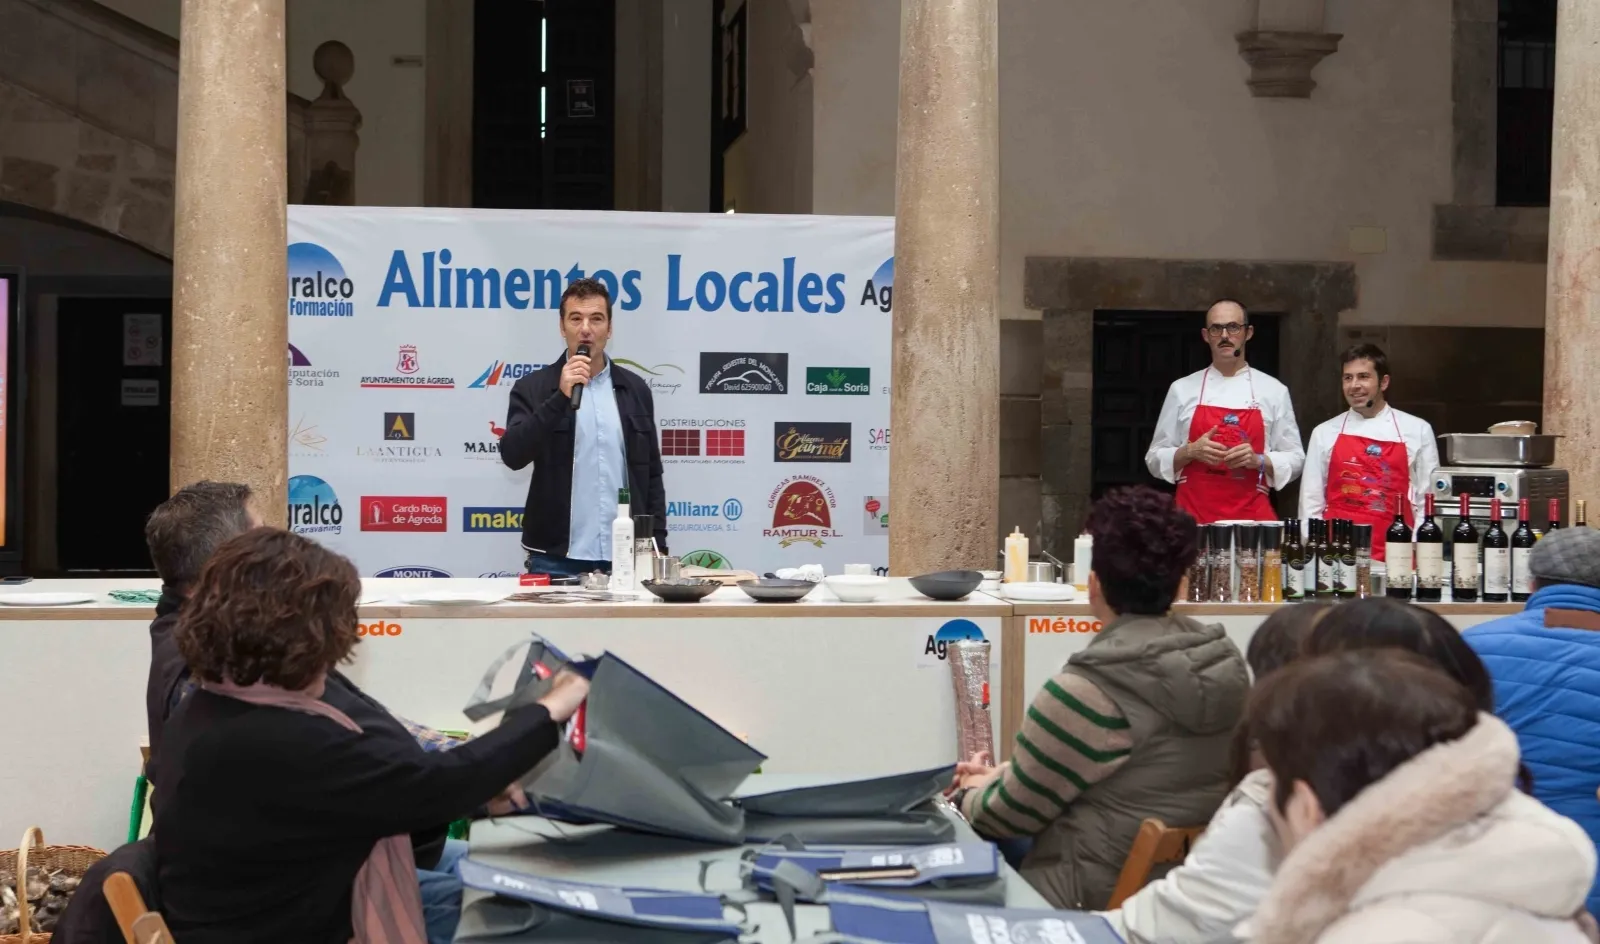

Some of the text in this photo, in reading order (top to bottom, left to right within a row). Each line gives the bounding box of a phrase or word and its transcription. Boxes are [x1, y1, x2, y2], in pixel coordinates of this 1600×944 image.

[666, 254, 846, 314] Locales
[290, 298, 353, 316] Formación
[360, 376, 415, 384] AYUNTAMIENTO
[427, 376, 455, 385] ÁGREDA
[748, 358, 758, 366] DEL
[759, 362, 785, 392] MONCAYO
[296, 377, 325, 387] Soria
[807, 382, 828, 394] Caja
[844, 382, 869, 393] Soria
[660, 419, 746, 428] DISTRIBUCIONES
[776, 432, 849, 460] Gourmet
[824, 487, 837, 509] TUTOR
[392, 504, 443, 515] Cardo Rojo
[666, 501, 719, 516] Allianz
[392, 513, 443, 526] de Ágreda
[293, 525, 342, 535] Caravaning
[763, 529, 844, 537] RAMTUR S.L.
[393, 570, 434, 578] MONTE
